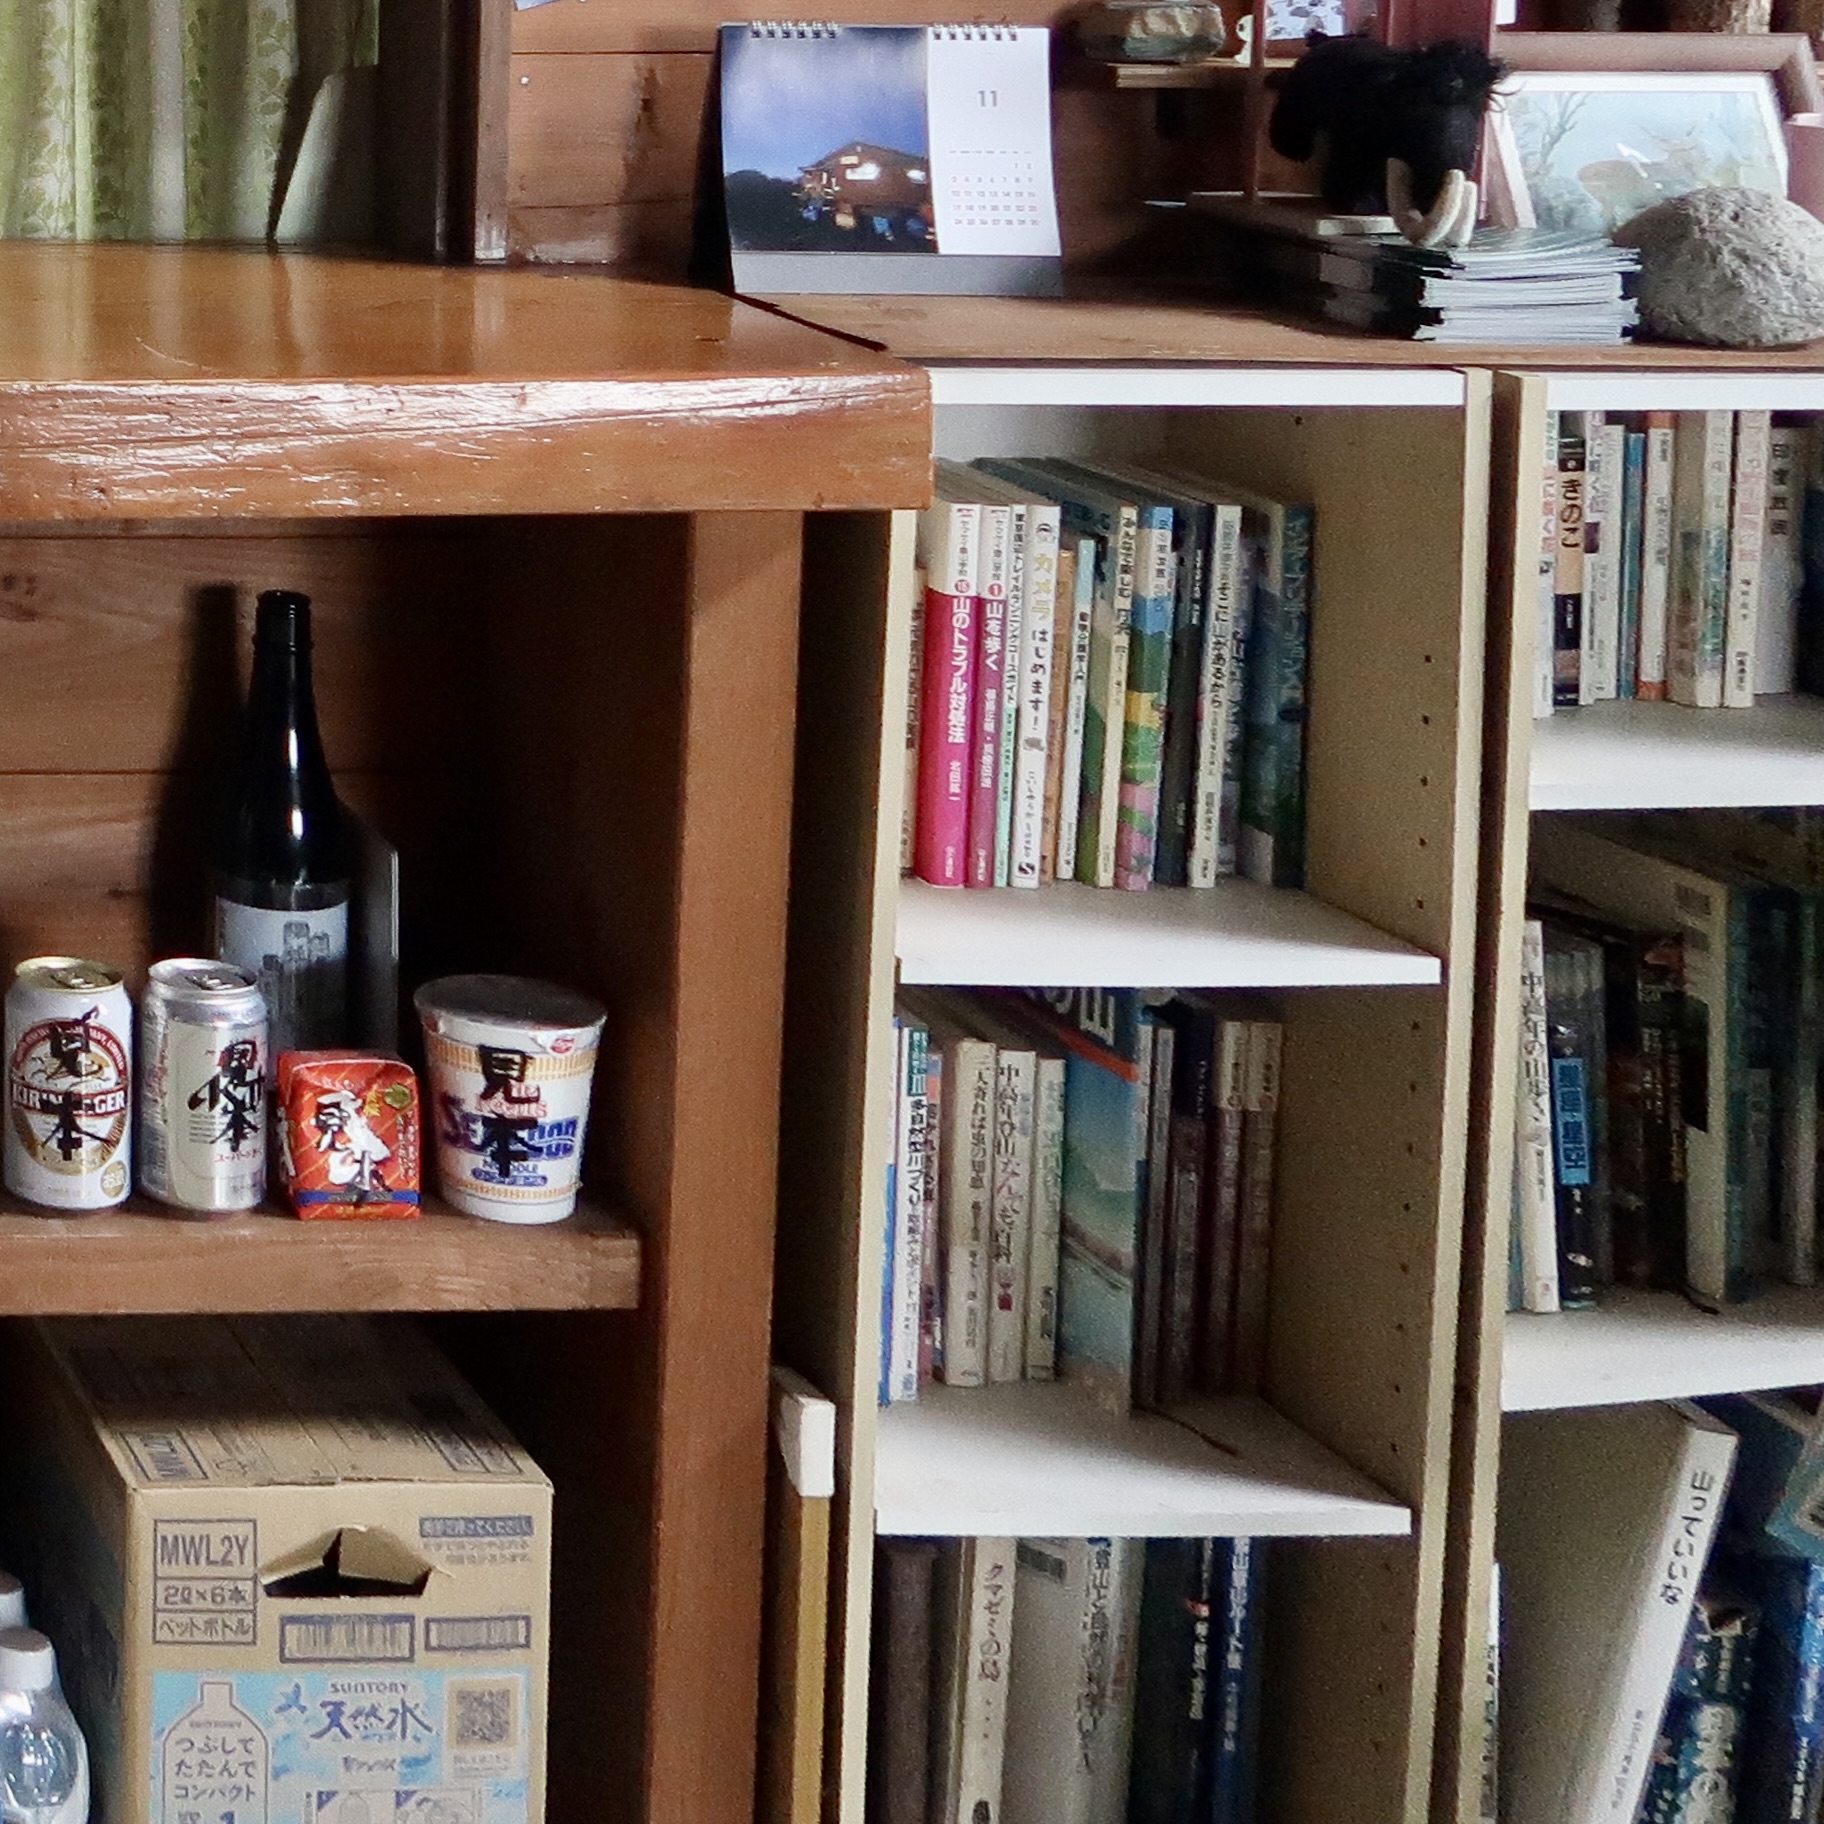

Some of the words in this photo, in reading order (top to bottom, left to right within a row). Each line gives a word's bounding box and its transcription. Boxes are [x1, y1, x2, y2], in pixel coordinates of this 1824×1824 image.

[979, 90, 998, 107] 11
[1559, 478, 1583, 549] きのこ
[983, 602, 1003, 671] 山を歩く
[477, 1044, 544, 1178] 見本
[160, 1535, 250, 1568] MWL2Y
[159, 1619, 252, 1639] ペットボトル
[329, 1683, 410, 1695] SUNTORY
[310, 1699, 433, 1740] 天然水
[175, 1735, 256, 1756] つぶして
[176, 1760, 256, 1779] たたんで
[174, 1785, 257, 1803] コンパクト
